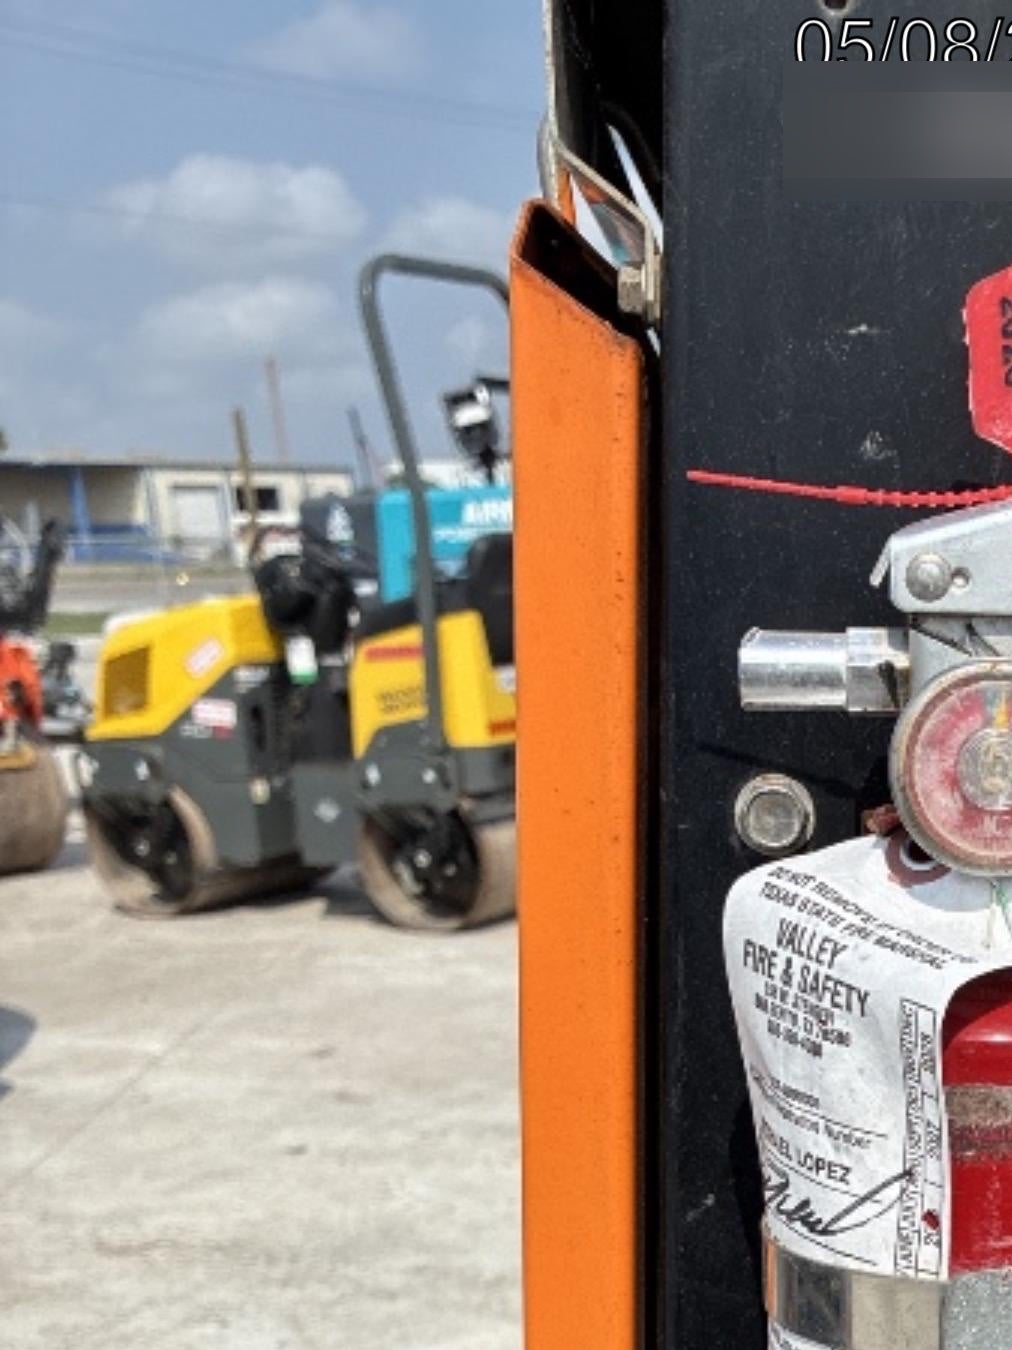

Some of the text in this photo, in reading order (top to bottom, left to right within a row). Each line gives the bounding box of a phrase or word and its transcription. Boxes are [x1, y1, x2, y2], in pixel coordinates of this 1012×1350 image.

[776, 917, 849, 970] VALLEY
[742, 938, 778, 981] FIRE
[778, 956, 793, 989] &
[798, 963, 871, 1018] SAFETY
[797, 1148, 852, 1185] LOPEZ
